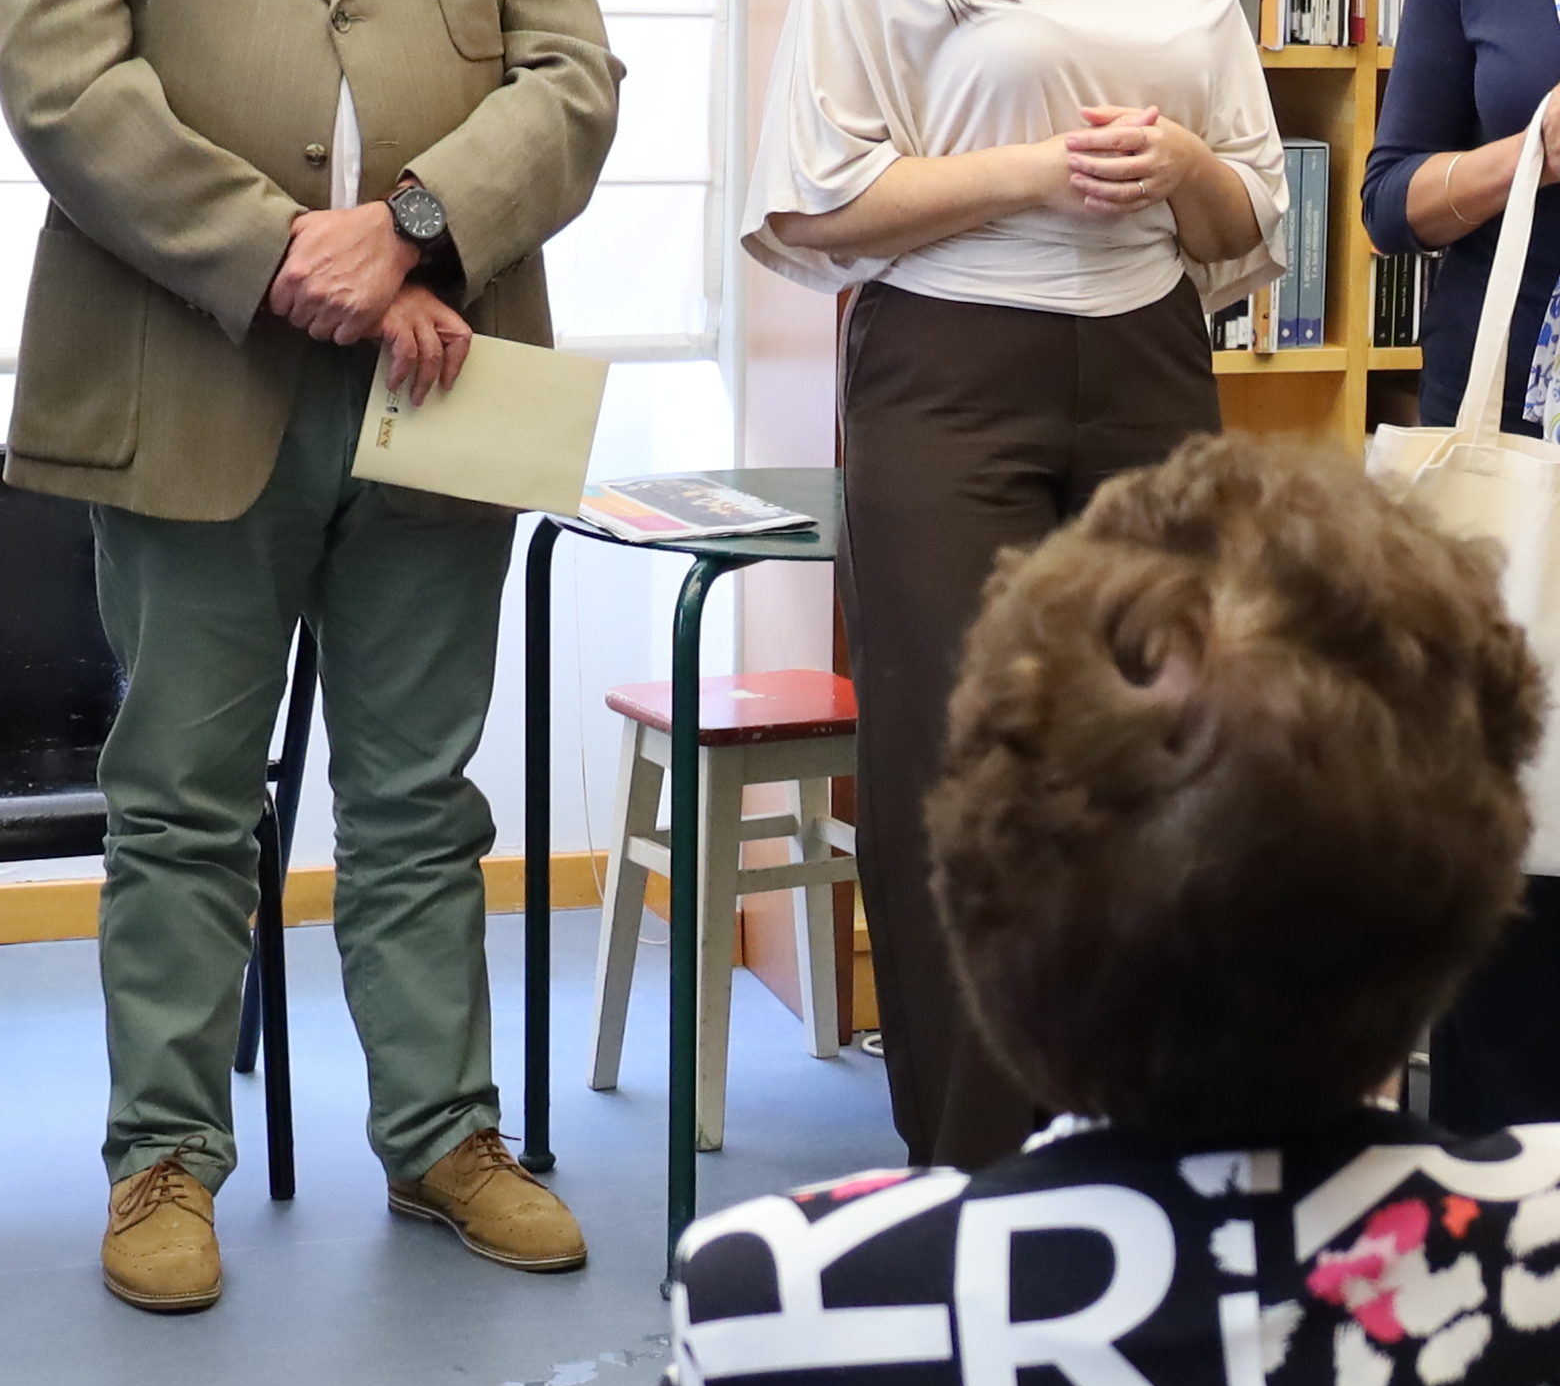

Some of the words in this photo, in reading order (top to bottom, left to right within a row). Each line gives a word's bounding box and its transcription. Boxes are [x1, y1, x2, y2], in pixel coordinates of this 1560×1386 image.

[1288, 209, 1296, 249] PERENIDADE
[1304, 199, 1313, 249] GRECO-LATINA
[1312, 210, 1320, 251] PERENIDADE
[1303, 250, 1312, 281] RETÓRICA
